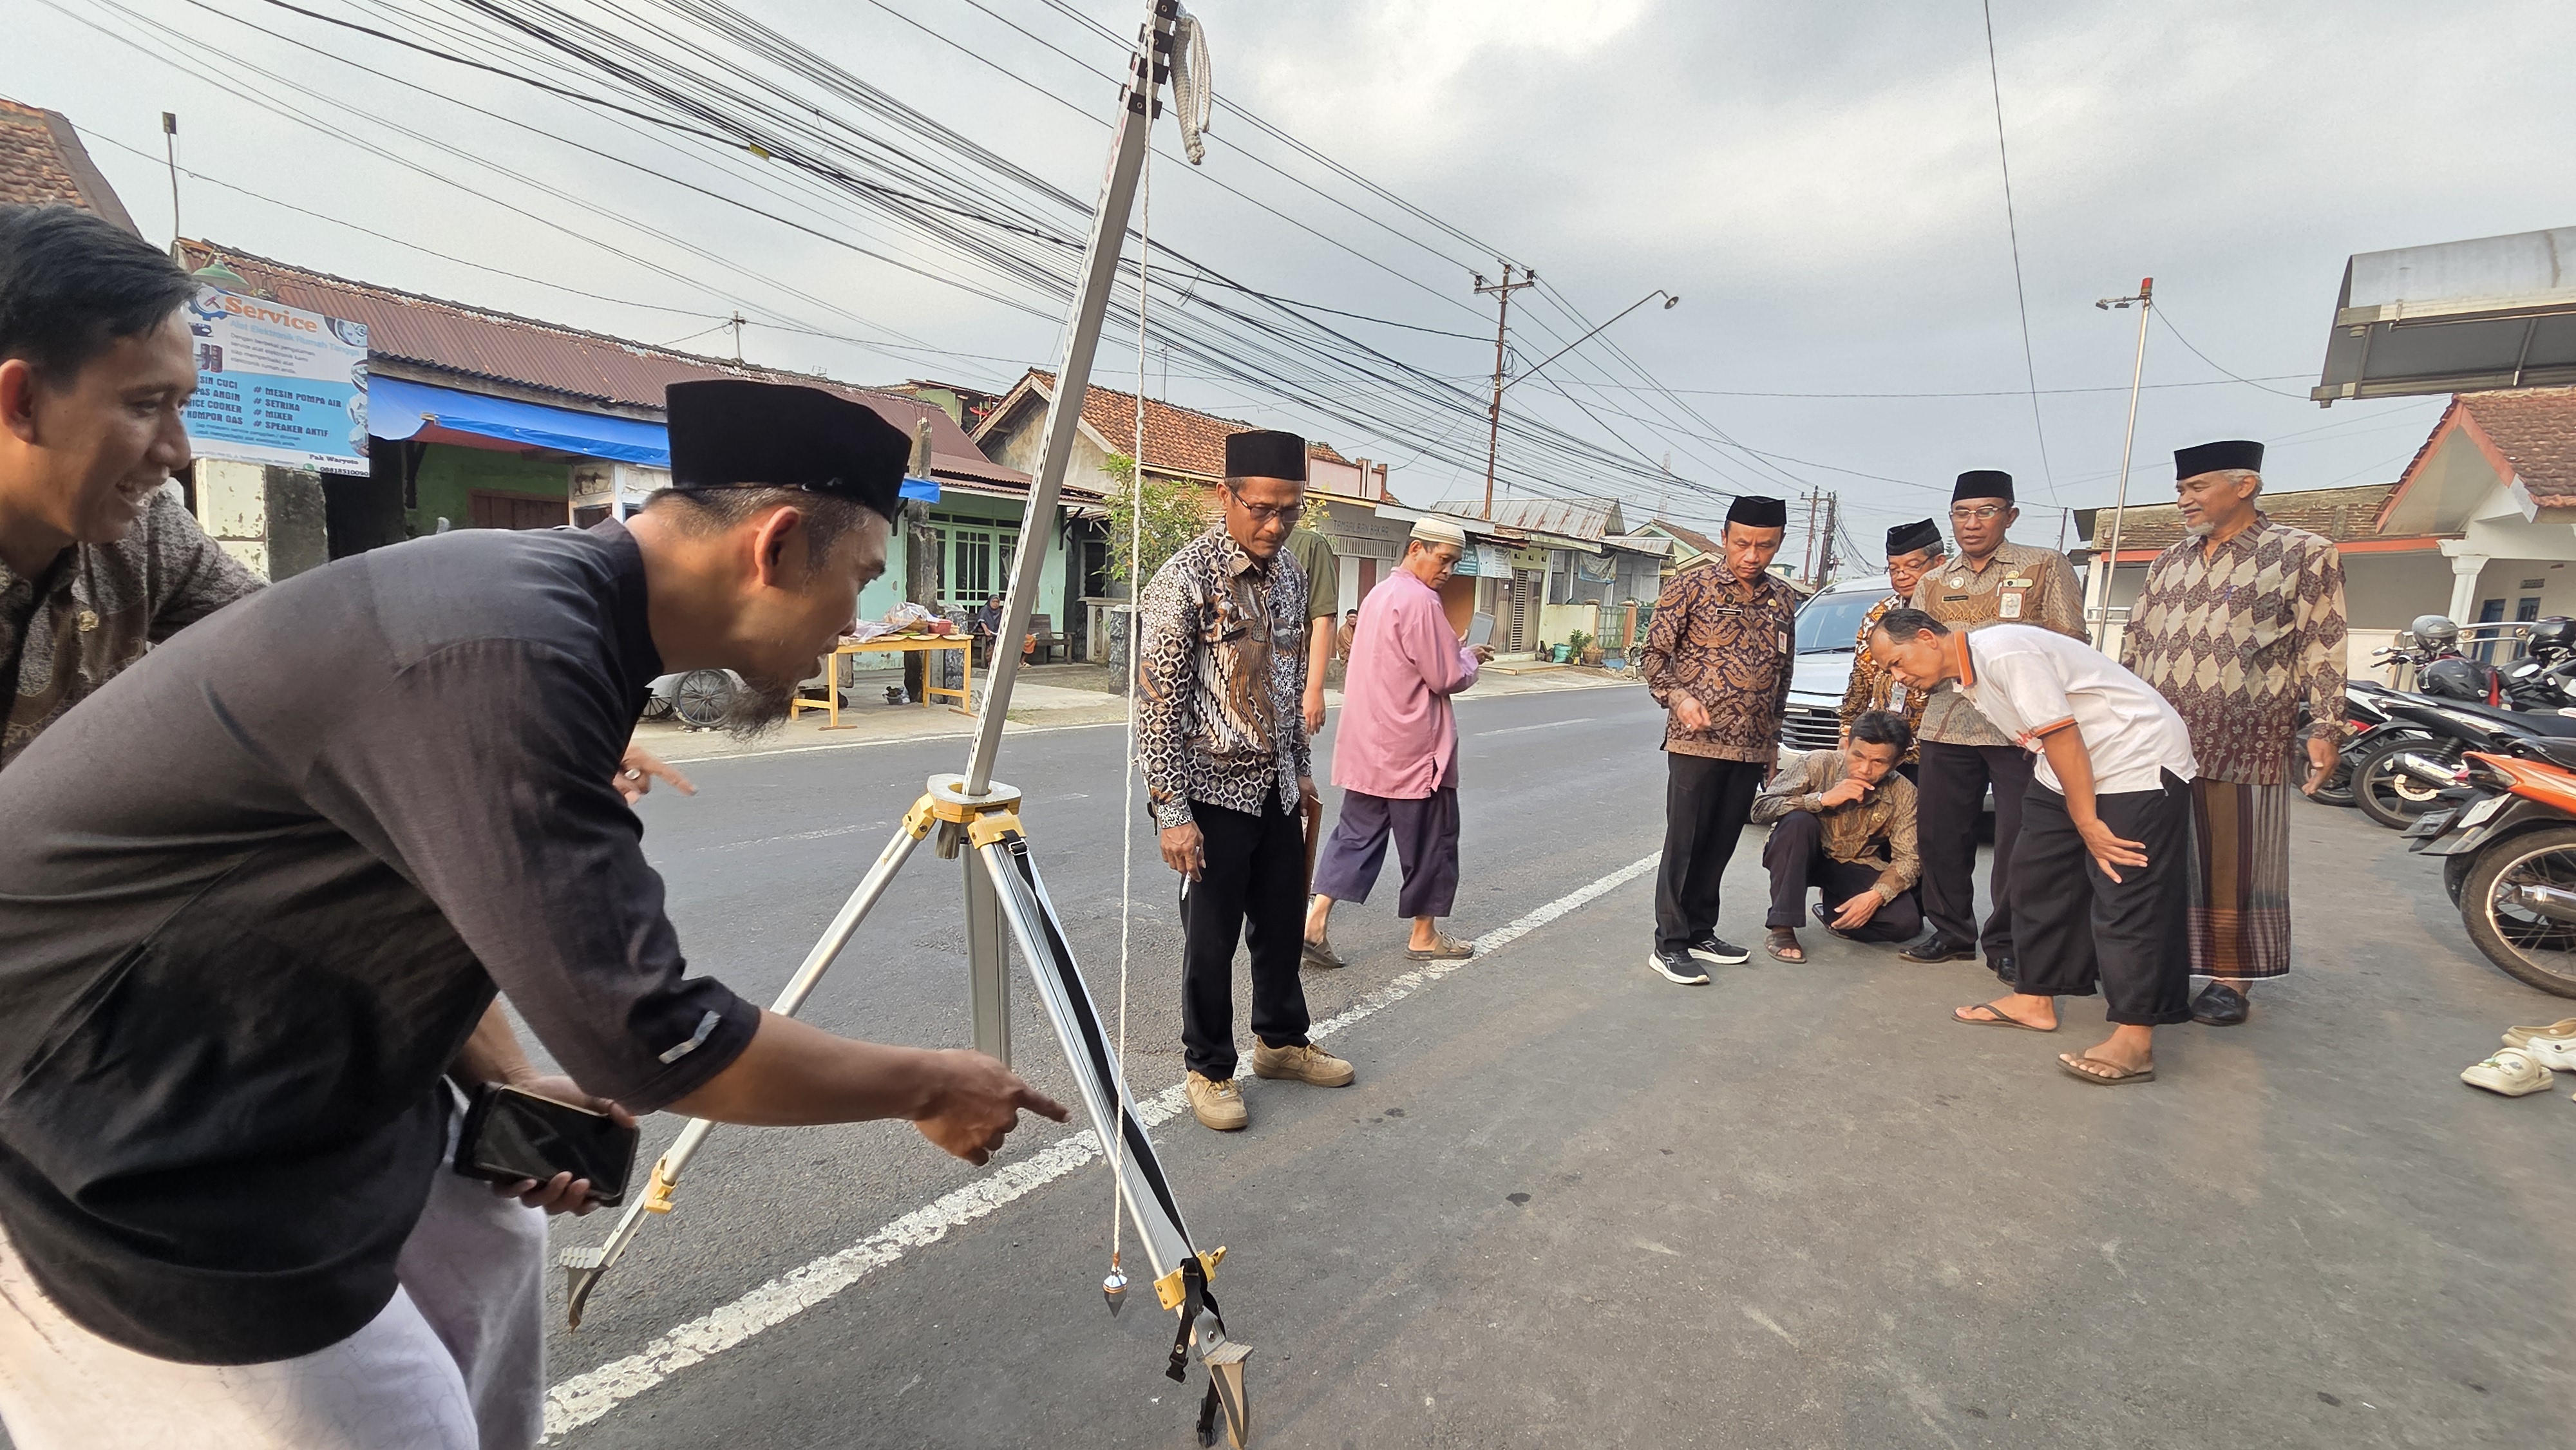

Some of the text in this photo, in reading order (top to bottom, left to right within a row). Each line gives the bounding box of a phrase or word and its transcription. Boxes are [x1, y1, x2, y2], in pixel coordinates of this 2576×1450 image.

[225, 296, 317, 333] Service
[230, 321, 360, 357] Alat Elektronik Rumah Tangga
[198, 376, 238, 389] SIN CUCI
[265, 387, 293, 399] MESIN
[296, 393, 325, 404] POMPA
[328, 399, 341, 408] AIR
[207, 400, 242, 413] COOKER
[265, 399, 300, 411] SETRIKA
[187, 410, 223, 422] KOMPOR
[265, 410, 293, 421] MIXER
[265, 421, 303, 434] SPEAKER
[305, 427, 328, 437] AKTIF
